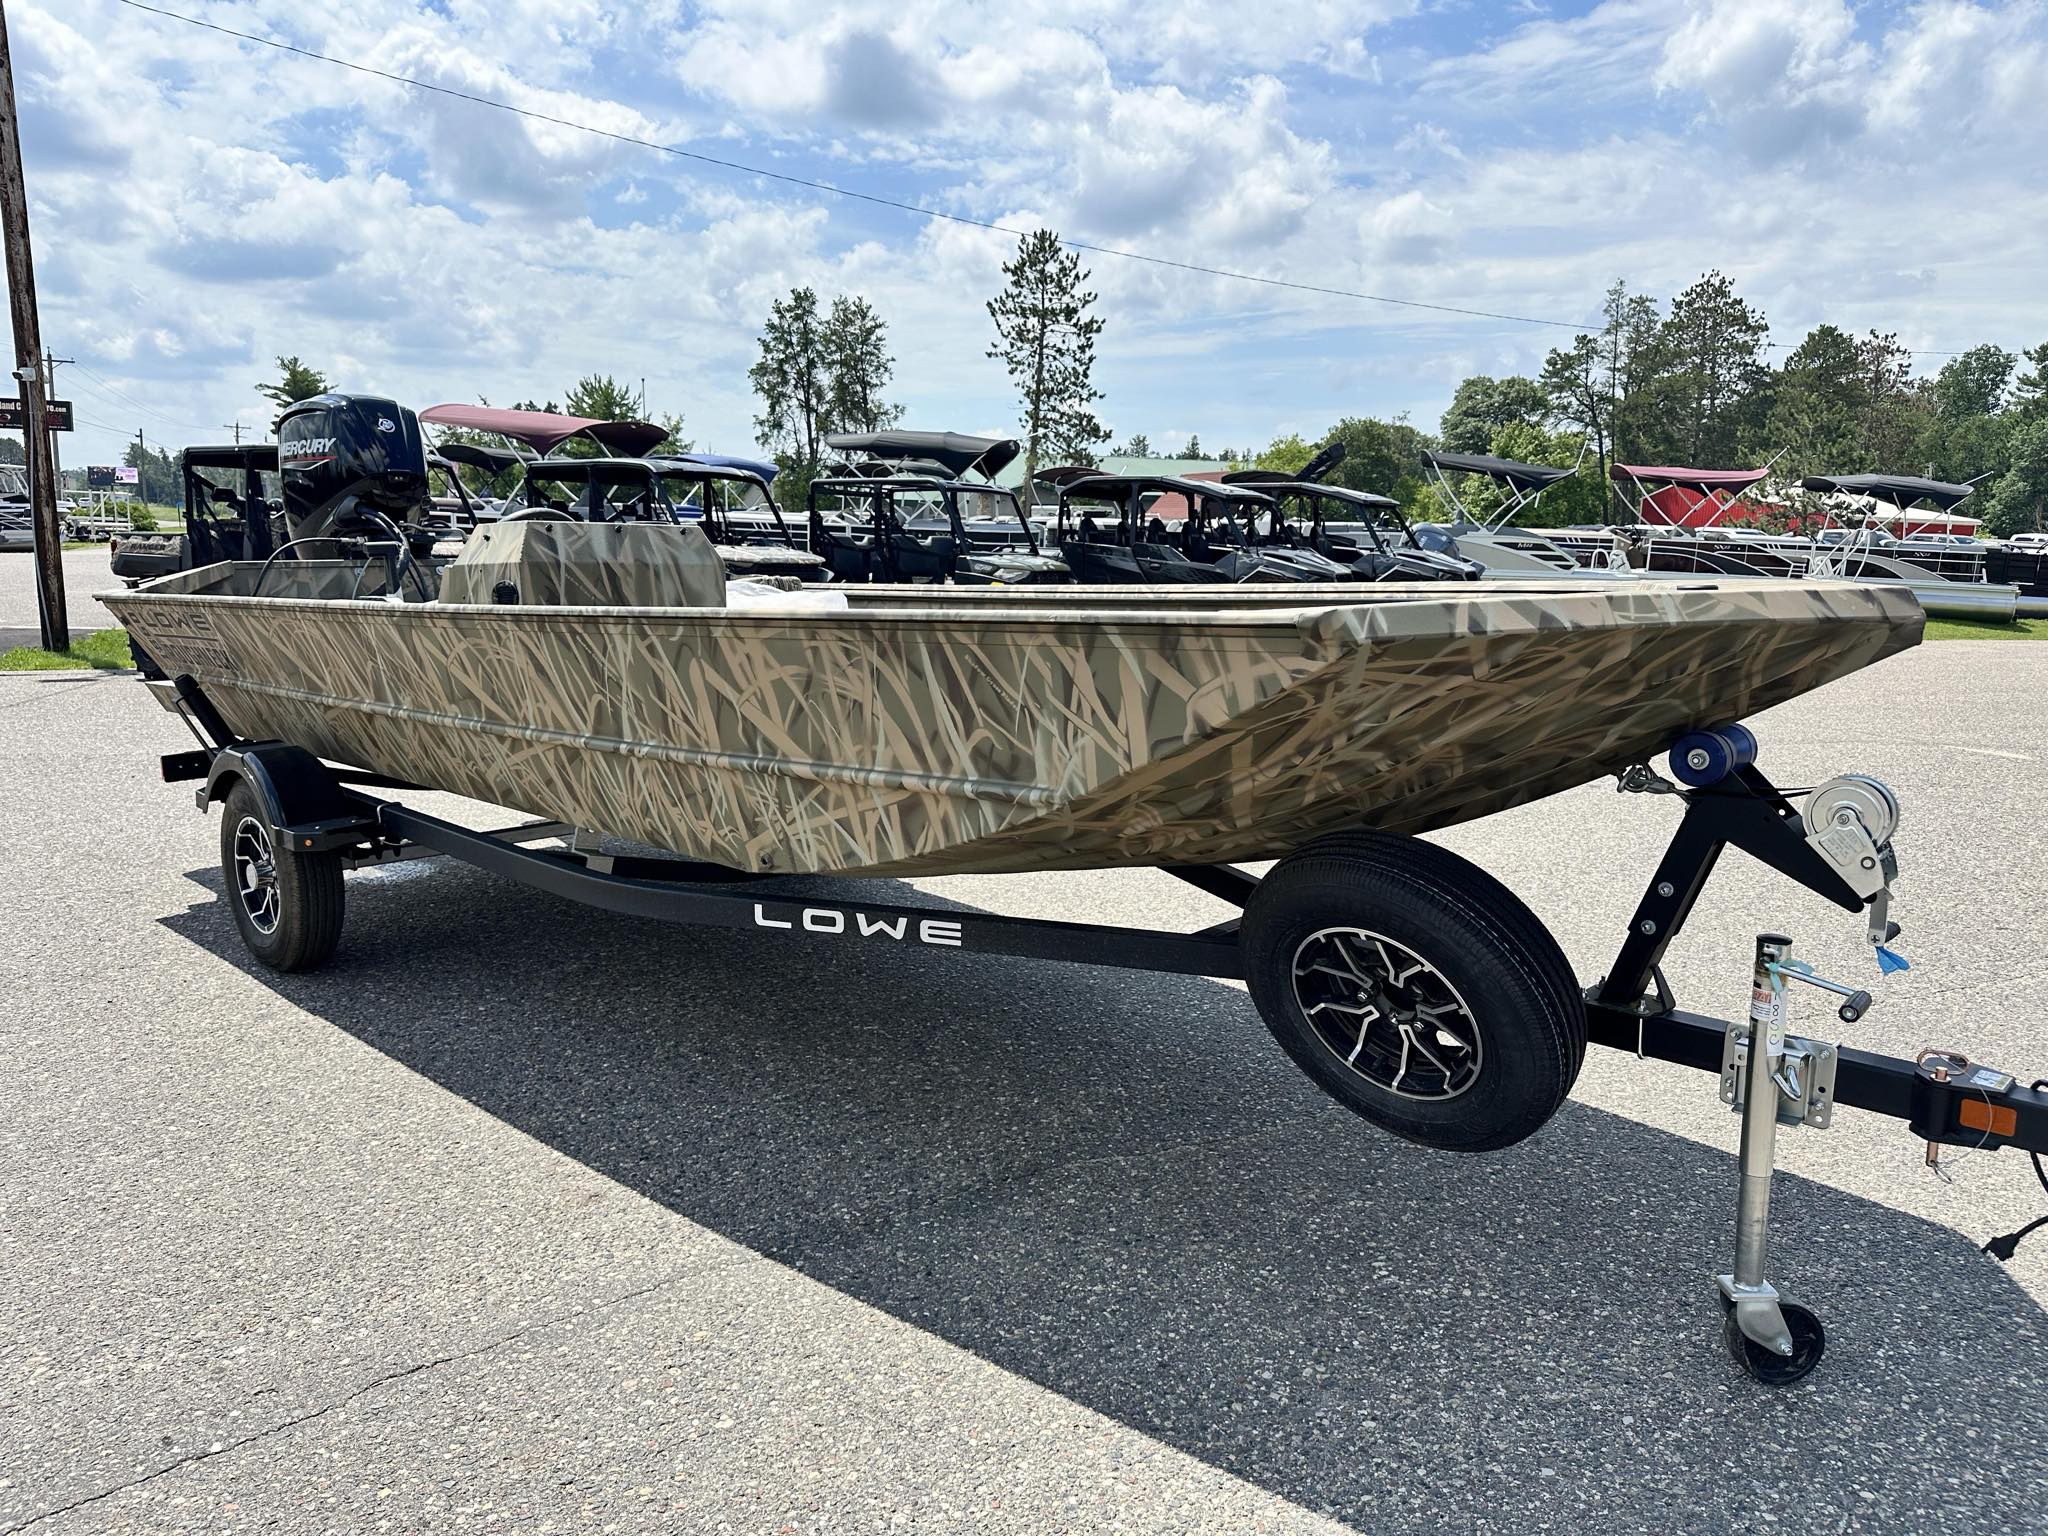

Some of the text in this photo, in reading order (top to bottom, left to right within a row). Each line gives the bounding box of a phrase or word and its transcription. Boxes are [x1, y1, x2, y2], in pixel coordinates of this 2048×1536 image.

[130, 543, 166, 551] RANGER
[139, 612, 211, 631] LOWE
[161, 643, 239, 671] ROUGHNECK
[754, 903, 962, 947] LOWE
